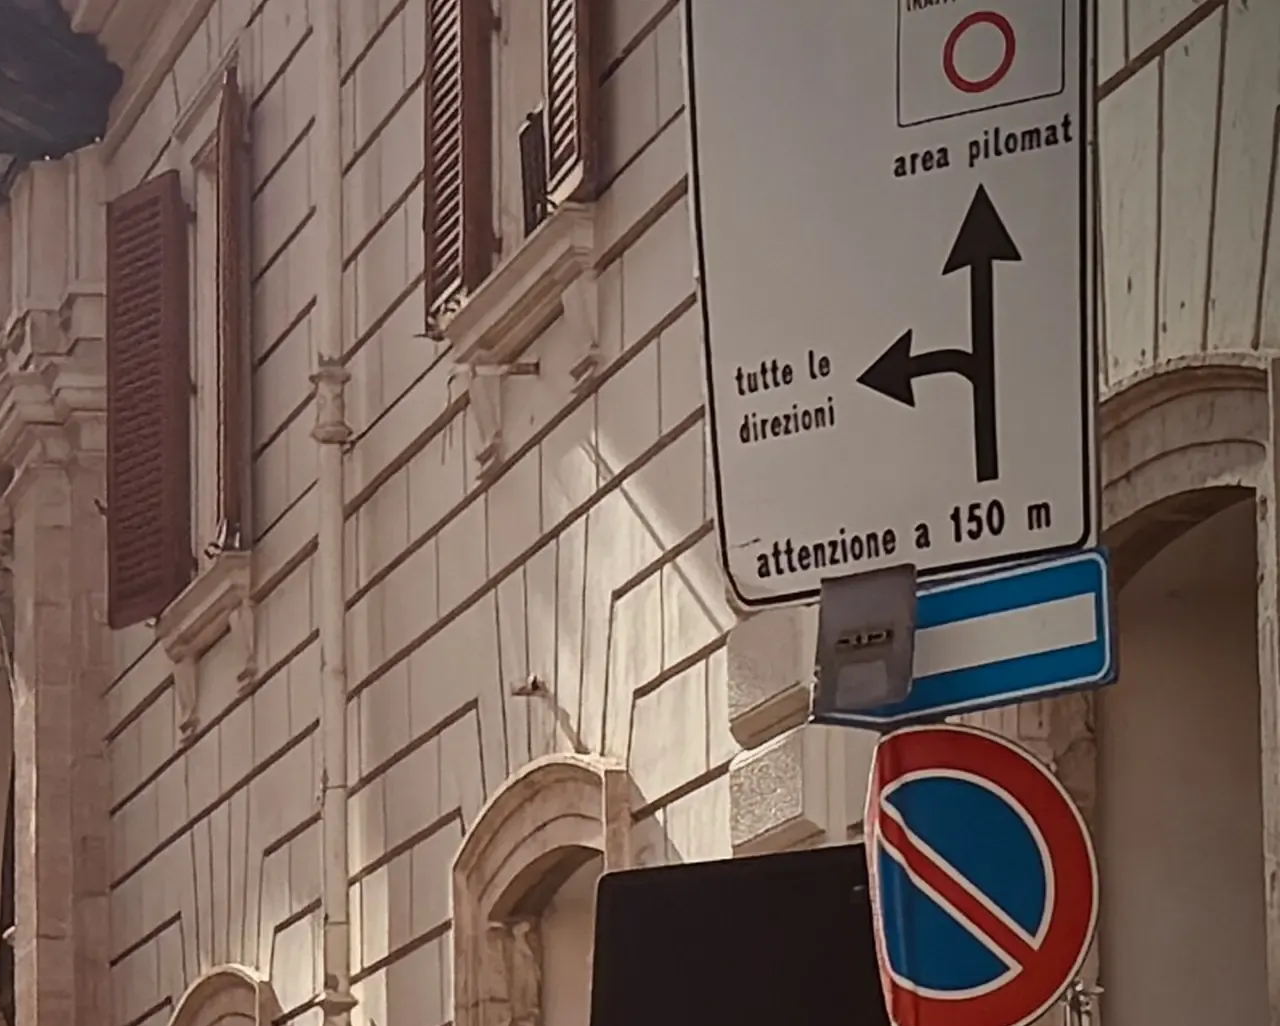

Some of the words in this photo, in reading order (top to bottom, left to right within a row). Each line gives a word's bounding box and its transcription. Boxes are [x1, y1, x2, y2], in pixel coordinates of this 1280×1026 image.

[893, 146, 950, 178] area
[968, 113, 1073, 168] pilomat
[735, 359, 793, 396] tutte
[808, 349, 831, 379] le
[739, 396, 834, 444] direzioni
[756, 528, 896, 578] attenzione
[915, 523, 931, 549] a
[950, 499, 1006, 543] 150
[1028, 501, 1052, 531] m
